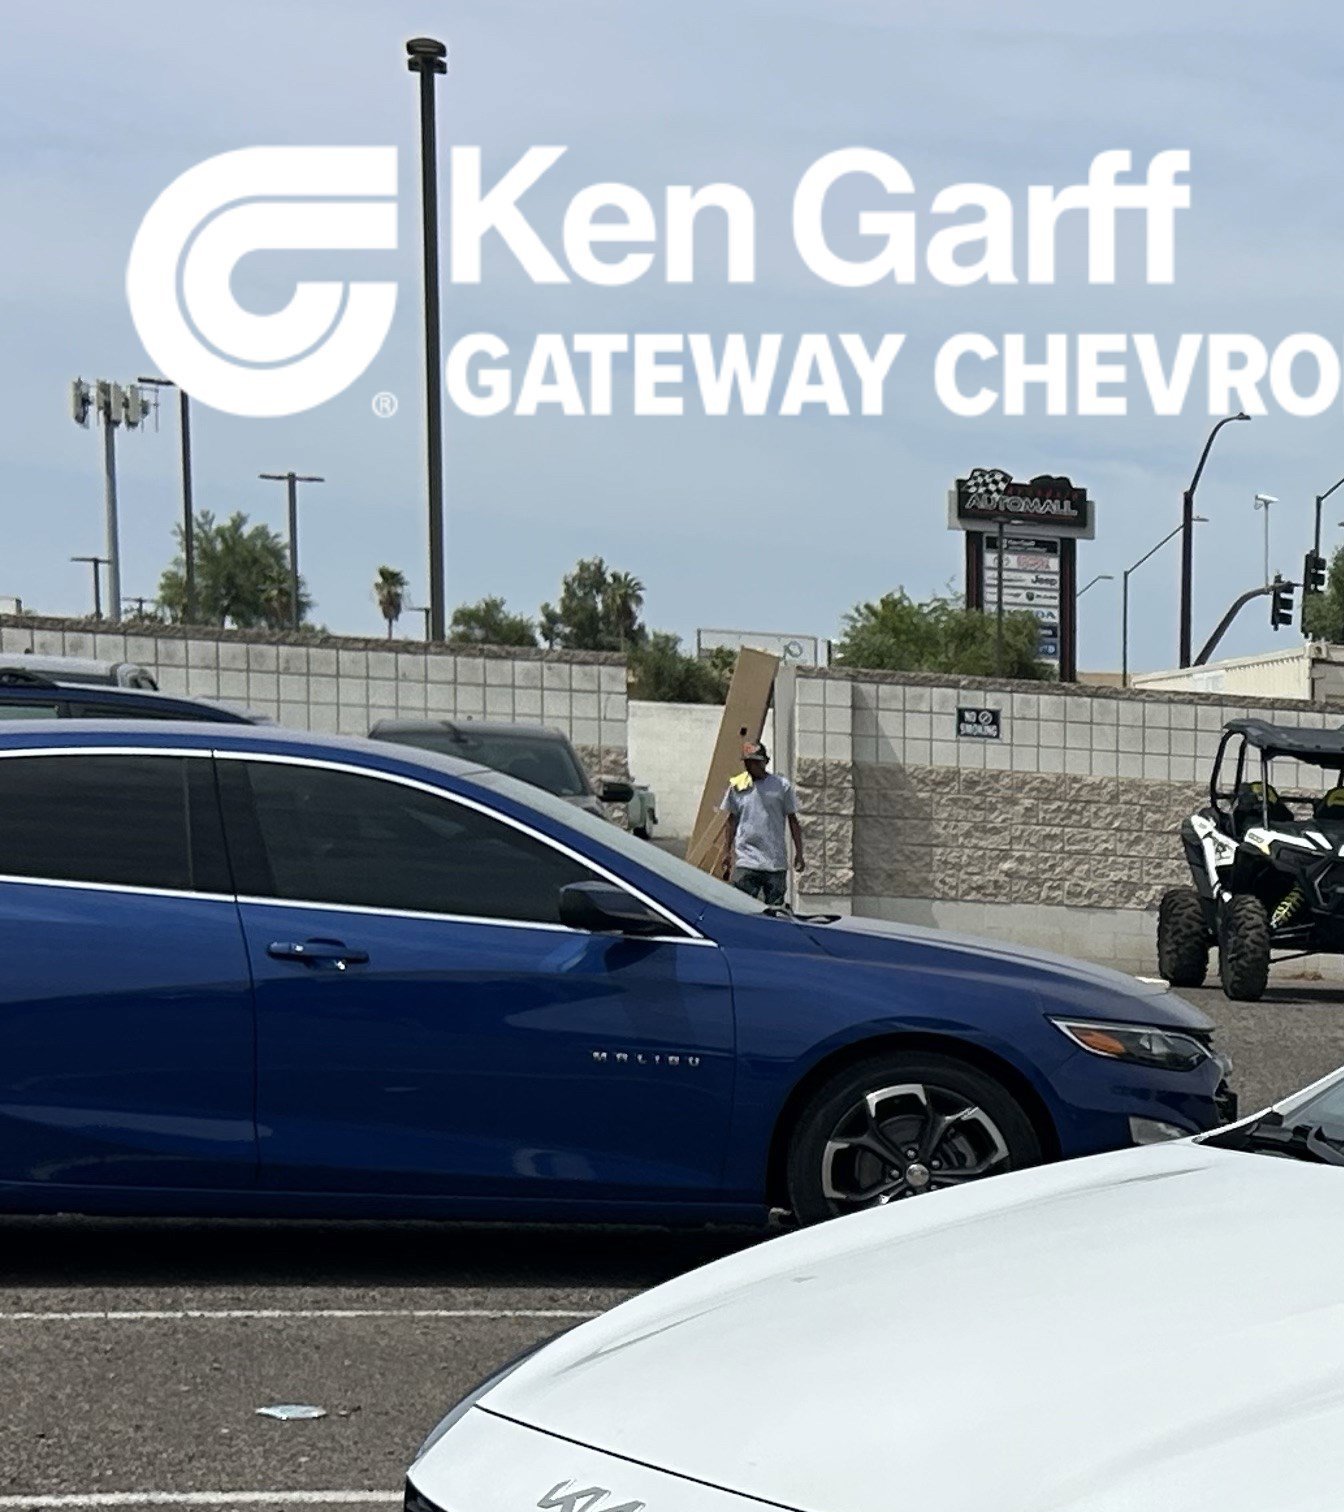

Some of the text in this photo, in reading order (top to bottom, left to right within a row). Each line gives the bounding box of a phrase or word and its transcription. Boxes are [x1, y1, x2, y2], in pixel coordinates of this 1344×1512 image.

[964, 494, 1079, 516] AUTOMALL
[964, 711, 976, 722] NO
[960, 723, 998, 737] SMOKING
[592, 1051, 700, 1067] MALIBU
